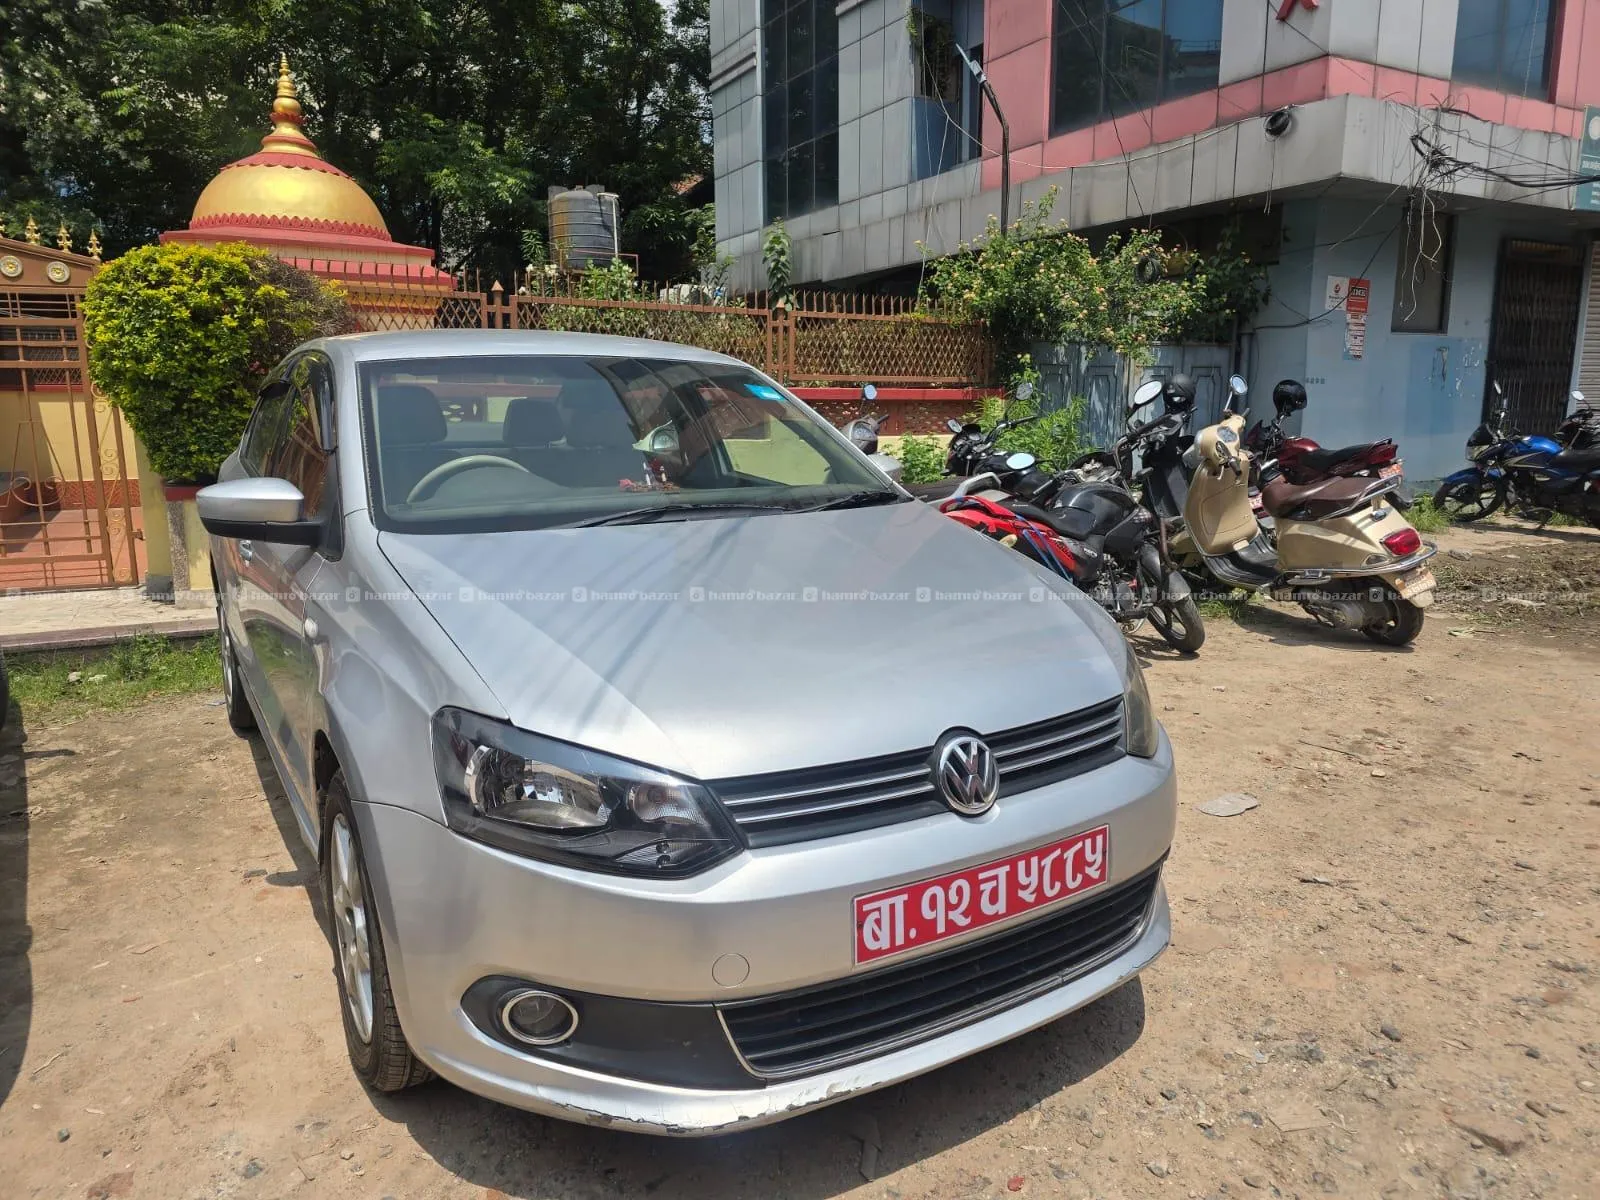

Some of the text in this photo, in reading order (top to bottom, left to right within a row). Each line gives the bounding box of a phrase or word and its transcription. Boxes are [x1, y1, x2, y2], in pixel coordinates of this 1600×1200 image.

[921, 878, 972, 934] १२
[977, 864, 1011, 916] च
[1017, 834, 1103, 903] ५८८५
